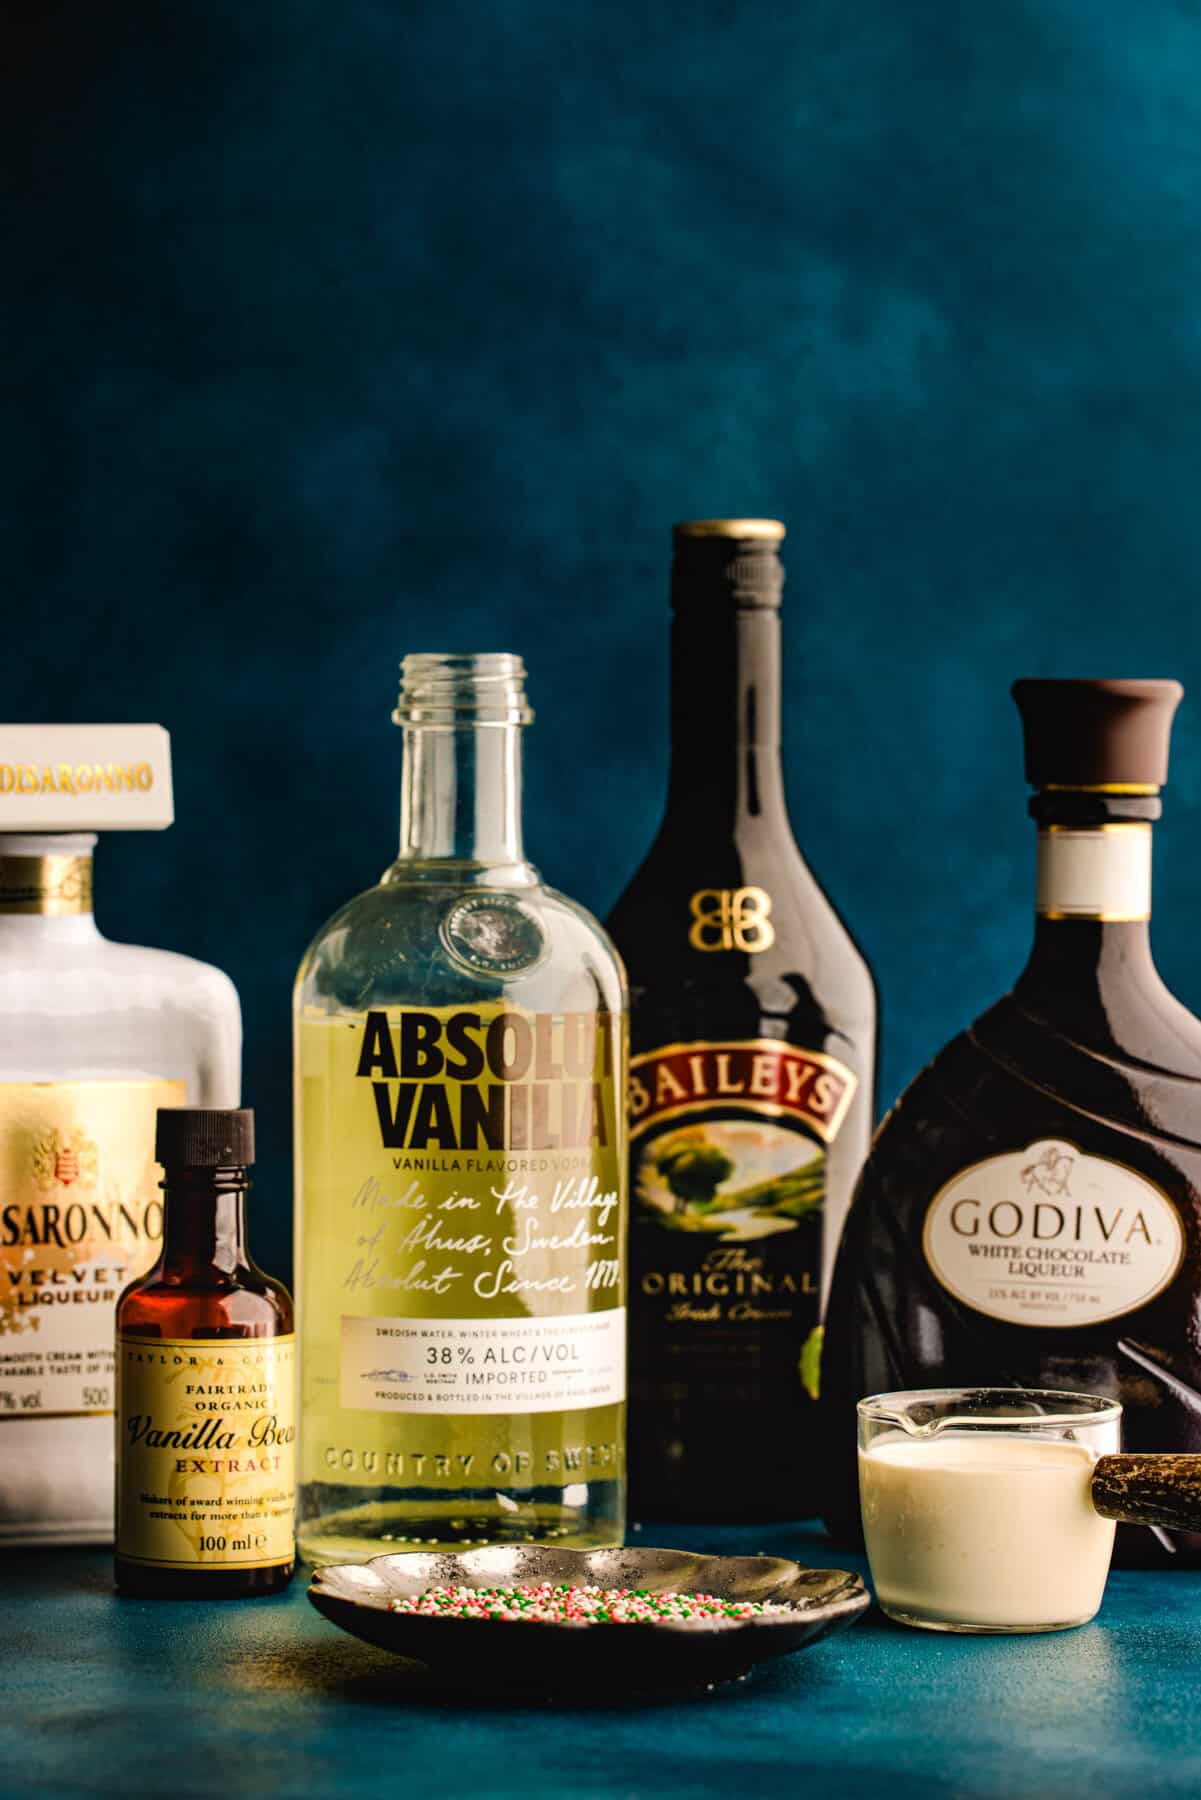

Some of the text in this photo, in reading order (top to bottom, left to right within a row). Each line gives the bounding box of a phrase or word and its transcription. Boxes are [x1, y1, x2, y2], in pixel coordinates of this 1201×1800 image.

[0, 761, 154, 796] DISARONNO
[629, 1053, 834, 1116] BAILEYS
[393, 1157, 461, 1171] VANILLA
[467, 1159, 549, 1172] FLAVORED
[352, 1176, 427, 1212] Made
[438, 1191, 480, 1210] in
[491, 1180, 539, 1214] the
[950, 1199, 1152, 1245] GODIVA
[358, 1223, 388, 1248] of
[702, 1248, 762, 1272] The
[968, 1244, 1131, 1264] WHITE CHOCOLATE
[8, 1266, 128, 1287] VELVET
[344, 1258, 464, 1294] Absolut
[474, 1260, 577, 1298] Since
[1008, 1261, 1086, 1278] LIQUEUR
[641, 1271, 818, 1296] ORIGINAL
[18, 1290, 115, 1306] LIQUEUR
[376, 1327, 418, 1337] SWEDISH
[128, 1352, 197, 1366] TAYLOR
[426, 1344, 580, 1365] 38% ALC/VOL
[465, 1370, 547, 1385] IMPORTED
[82, 1386, 109, 1407] 500
[185, 1383, 271, 1395] FAIRTRAD
[375, 1391, 424, 1401] PRODUCED
[195, 1400, 268, 1412] ORGANIC
[128, 1415, 296, 1450] Vanilla Bea
[175, 1456, 282, 1473] EXTRACT
[323, 1447, 475, 1477] COUNTRY
[491, 1449, 531, 1473] OF
[176, 1496, 188, 1507] of
[190, 1495, 223, 1507] award
[226, 1494, 264, 1507] winning
[191, 1509, 207, 1521] for
[210, 1511, 238, 1521] more
[200, 1535, 227, 1551] 100
[232, 1533, 251, 1551] ml
